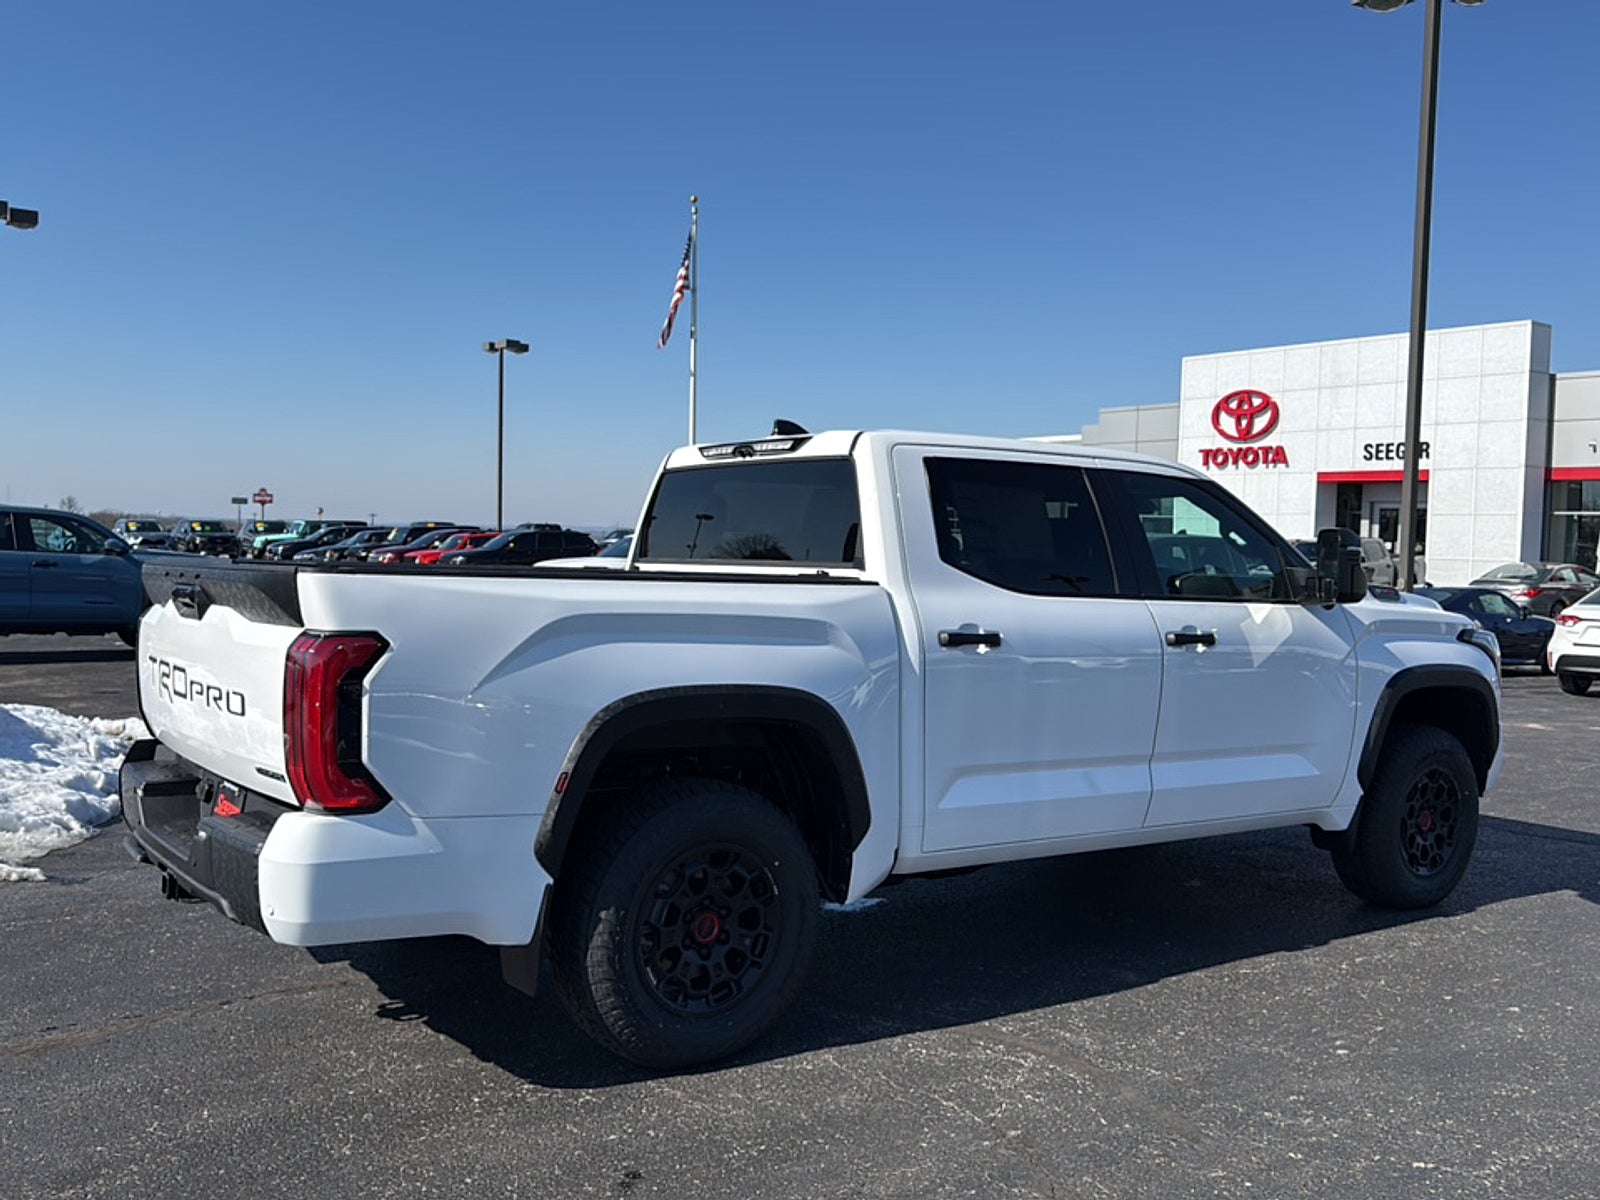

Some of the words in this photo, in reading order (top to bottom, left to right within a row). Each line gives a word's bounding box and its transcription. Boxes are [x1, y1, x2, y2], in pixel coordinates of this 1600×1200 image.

[1199, 445, 1289, 469] TOYOTA
[1363, 441, 1430, 461] SEEGR
[189, 679, 246, 717] PRO
